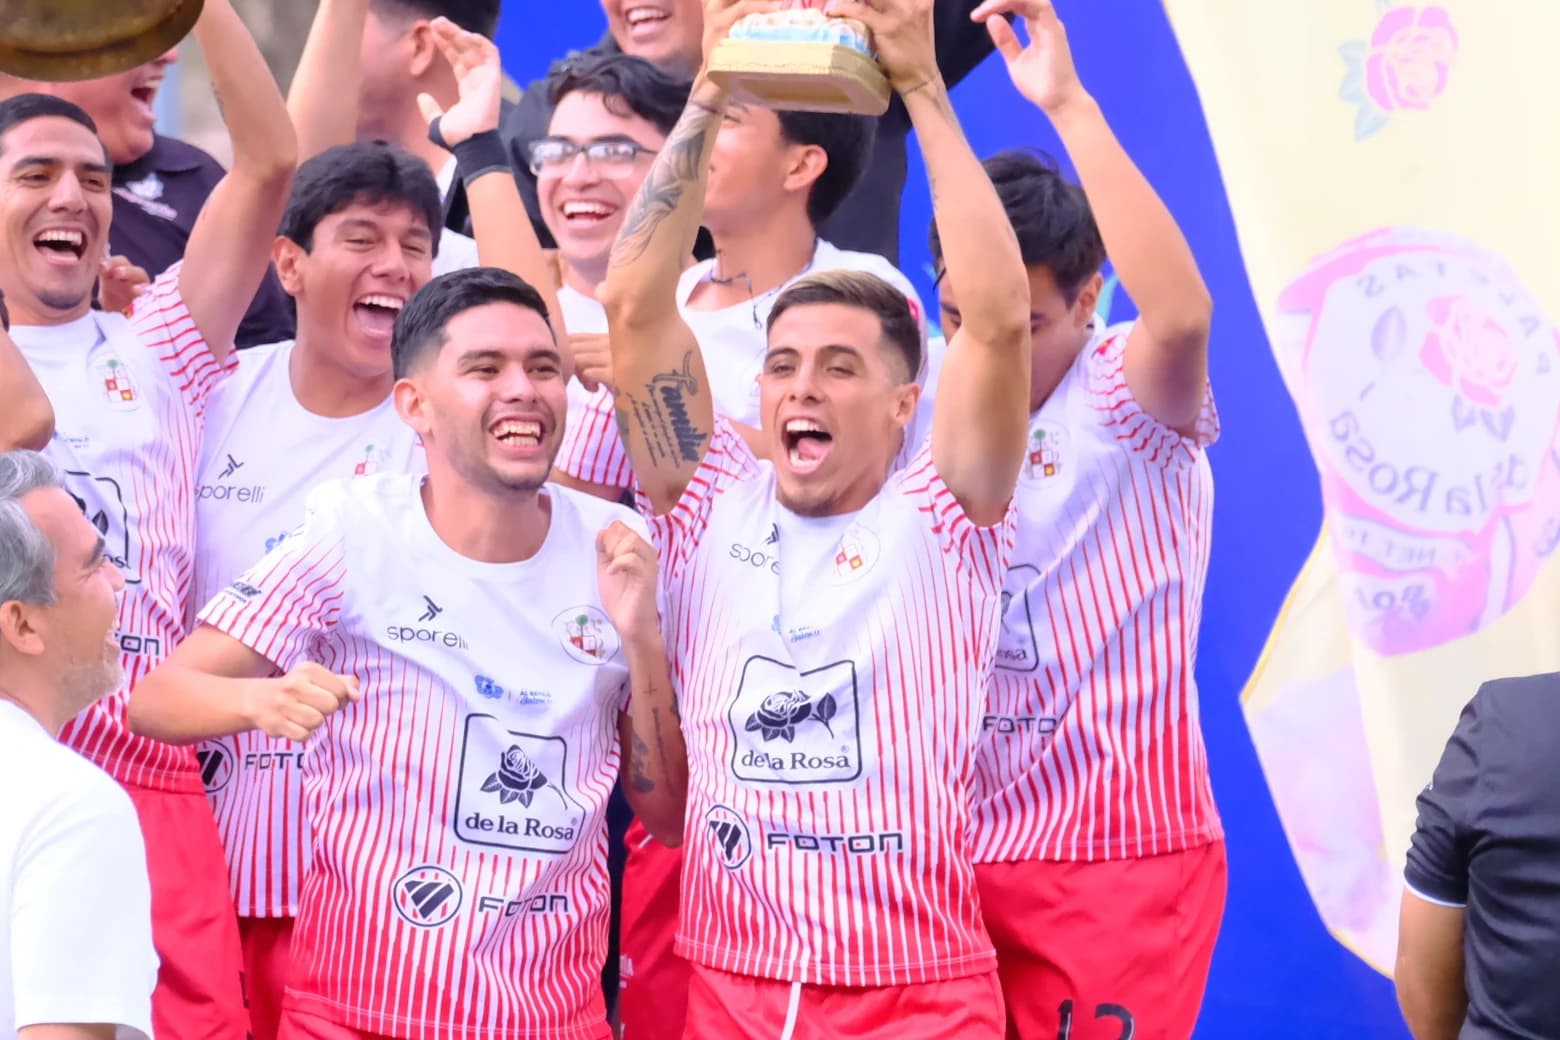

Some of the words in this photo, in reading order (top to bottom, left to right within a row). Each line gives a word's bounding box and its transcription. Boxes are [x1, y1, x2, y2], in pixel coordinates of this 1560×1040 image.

[982, 715, 1057, 734] FOTO
[741, 749, 765, 768] de
[763, 752, 785, 770] la
[790, 751, 851, 770] Rosa
[465, 811, 495, 832] de
[496, 813, 519, 836] la
[522, 817, 574, 841] Rosa
[767, 832, 903, 853] FOTON
